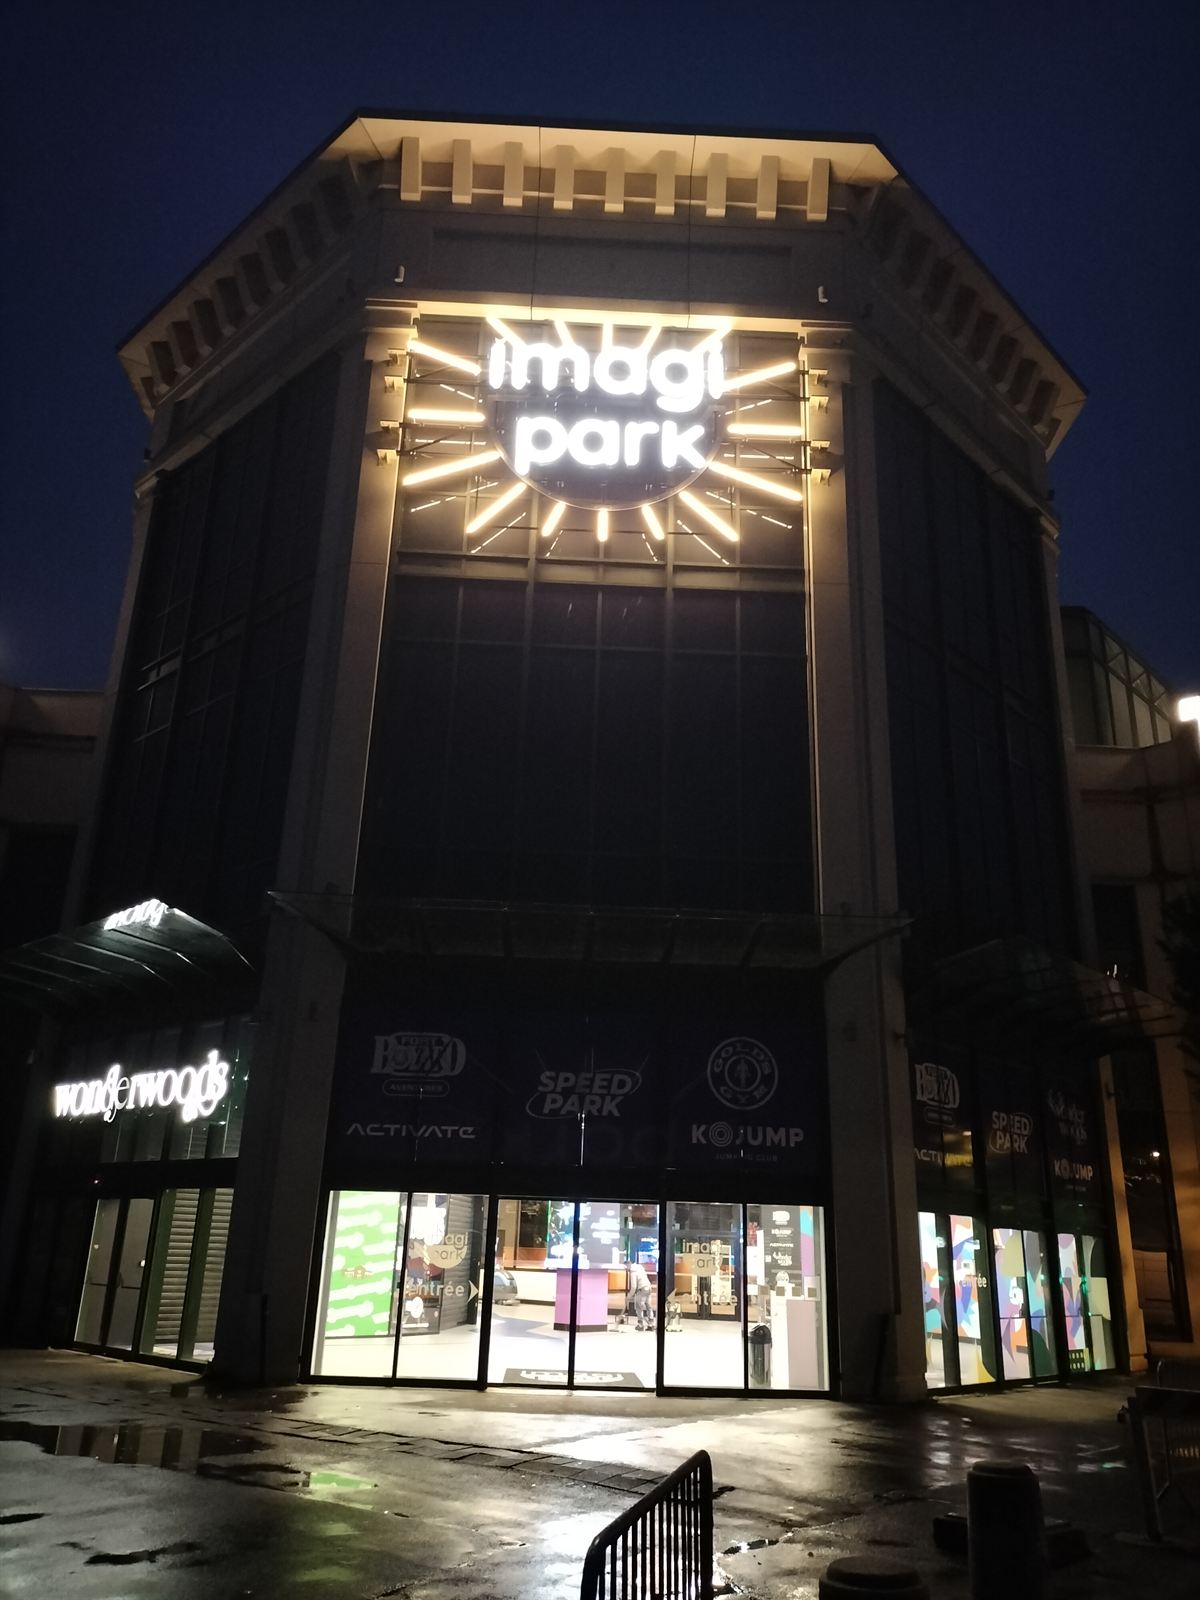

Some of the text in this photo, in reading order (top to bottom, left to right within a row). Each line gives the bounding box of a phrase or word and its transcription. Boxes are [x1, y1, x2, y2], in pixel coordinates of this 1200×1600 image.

[487, 336, 727, 414] imagi
[513, 415, 708, 477] park
[54, 1049, 230, 1123] wonderwoods
[537, 1070, 633, 1095] SPEED
[542, 1092, 625, 1117] PARK
[346, 1122, 477, 1139] ACTIVATE
[996, 1130, 1029, 1155] PARK
